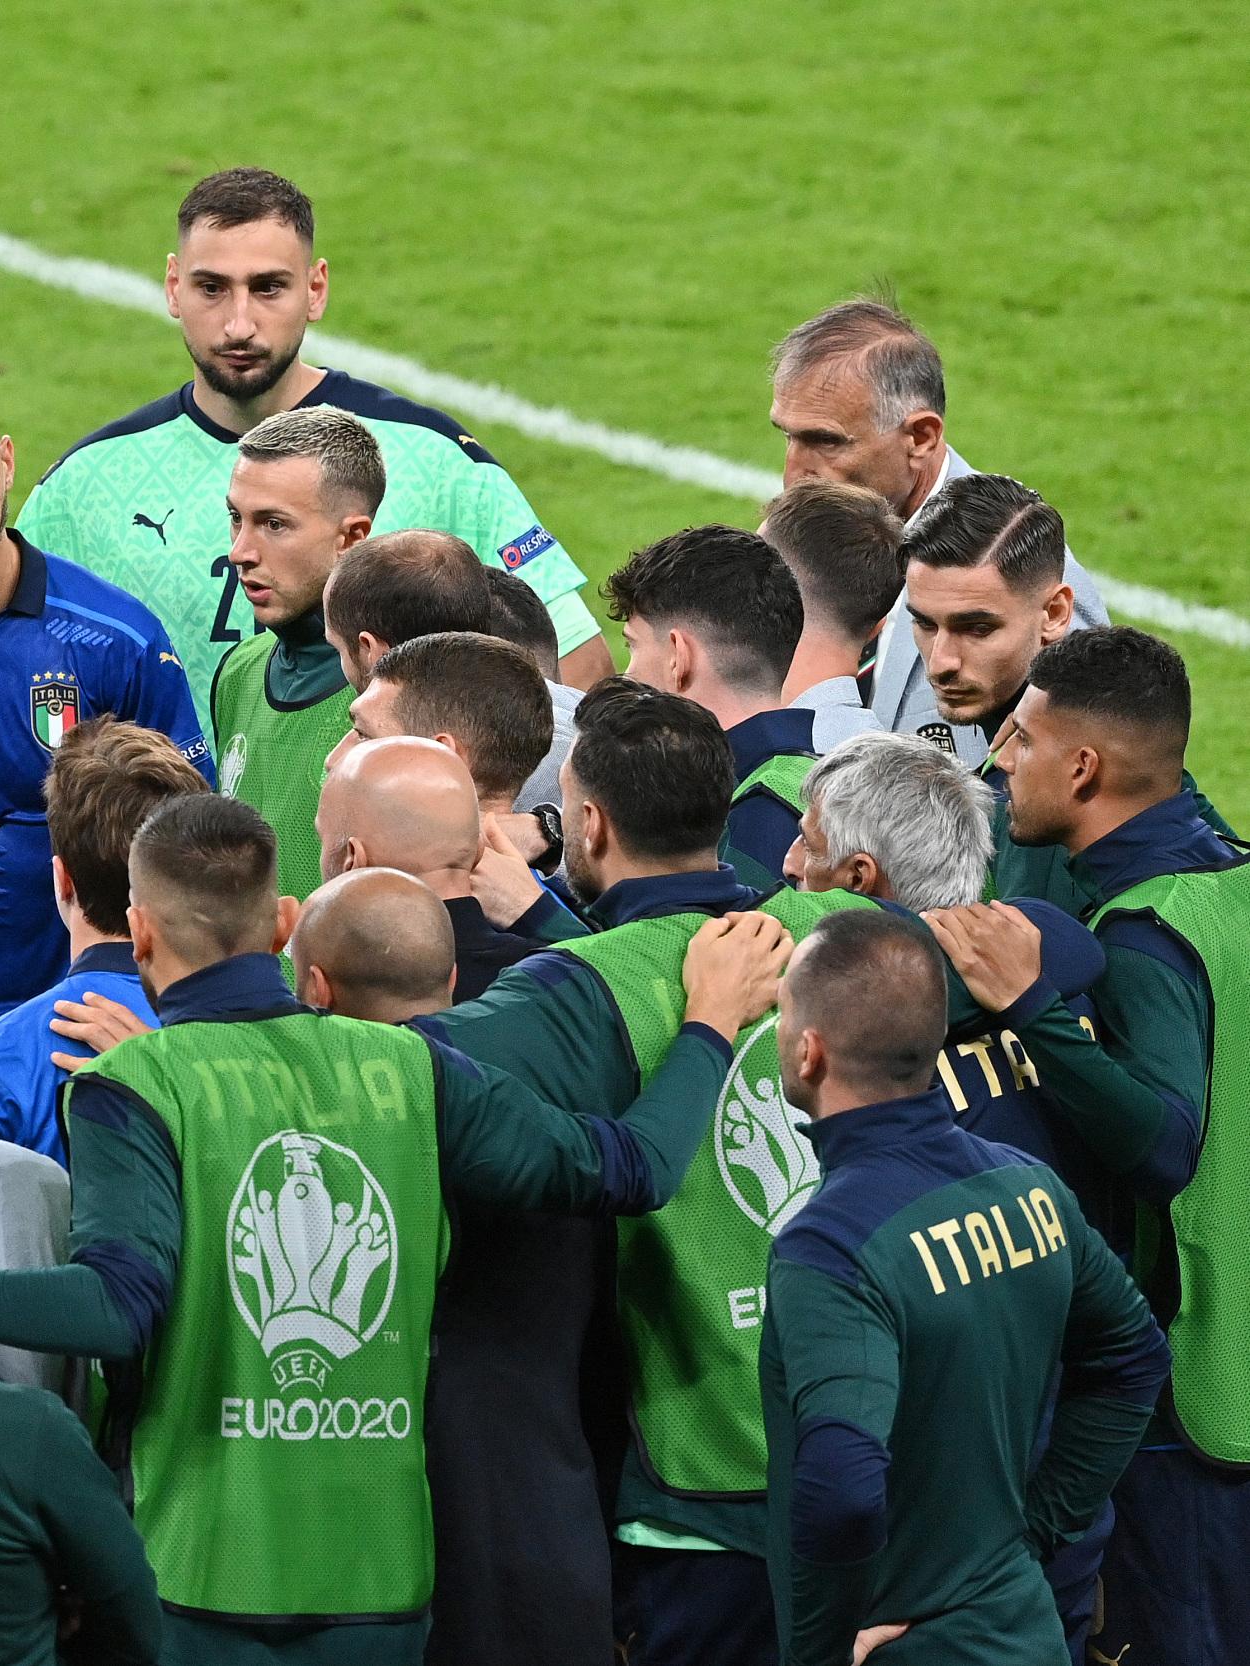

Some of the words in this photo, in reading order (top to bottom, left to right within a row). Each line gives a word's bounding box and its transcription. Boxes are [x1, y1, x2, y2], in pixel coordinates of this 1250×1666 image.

[35, 688, 75, 701] ITALIA
[192, 1058, 407, 1129] ITALIA
[909, 1187, 1067, 1295] ITALIA
[382, 1331, 400, 1344] TM
[272, 1356, 326, 1388] UEFA
[221, 1397, 411, 1440] EURO2020
